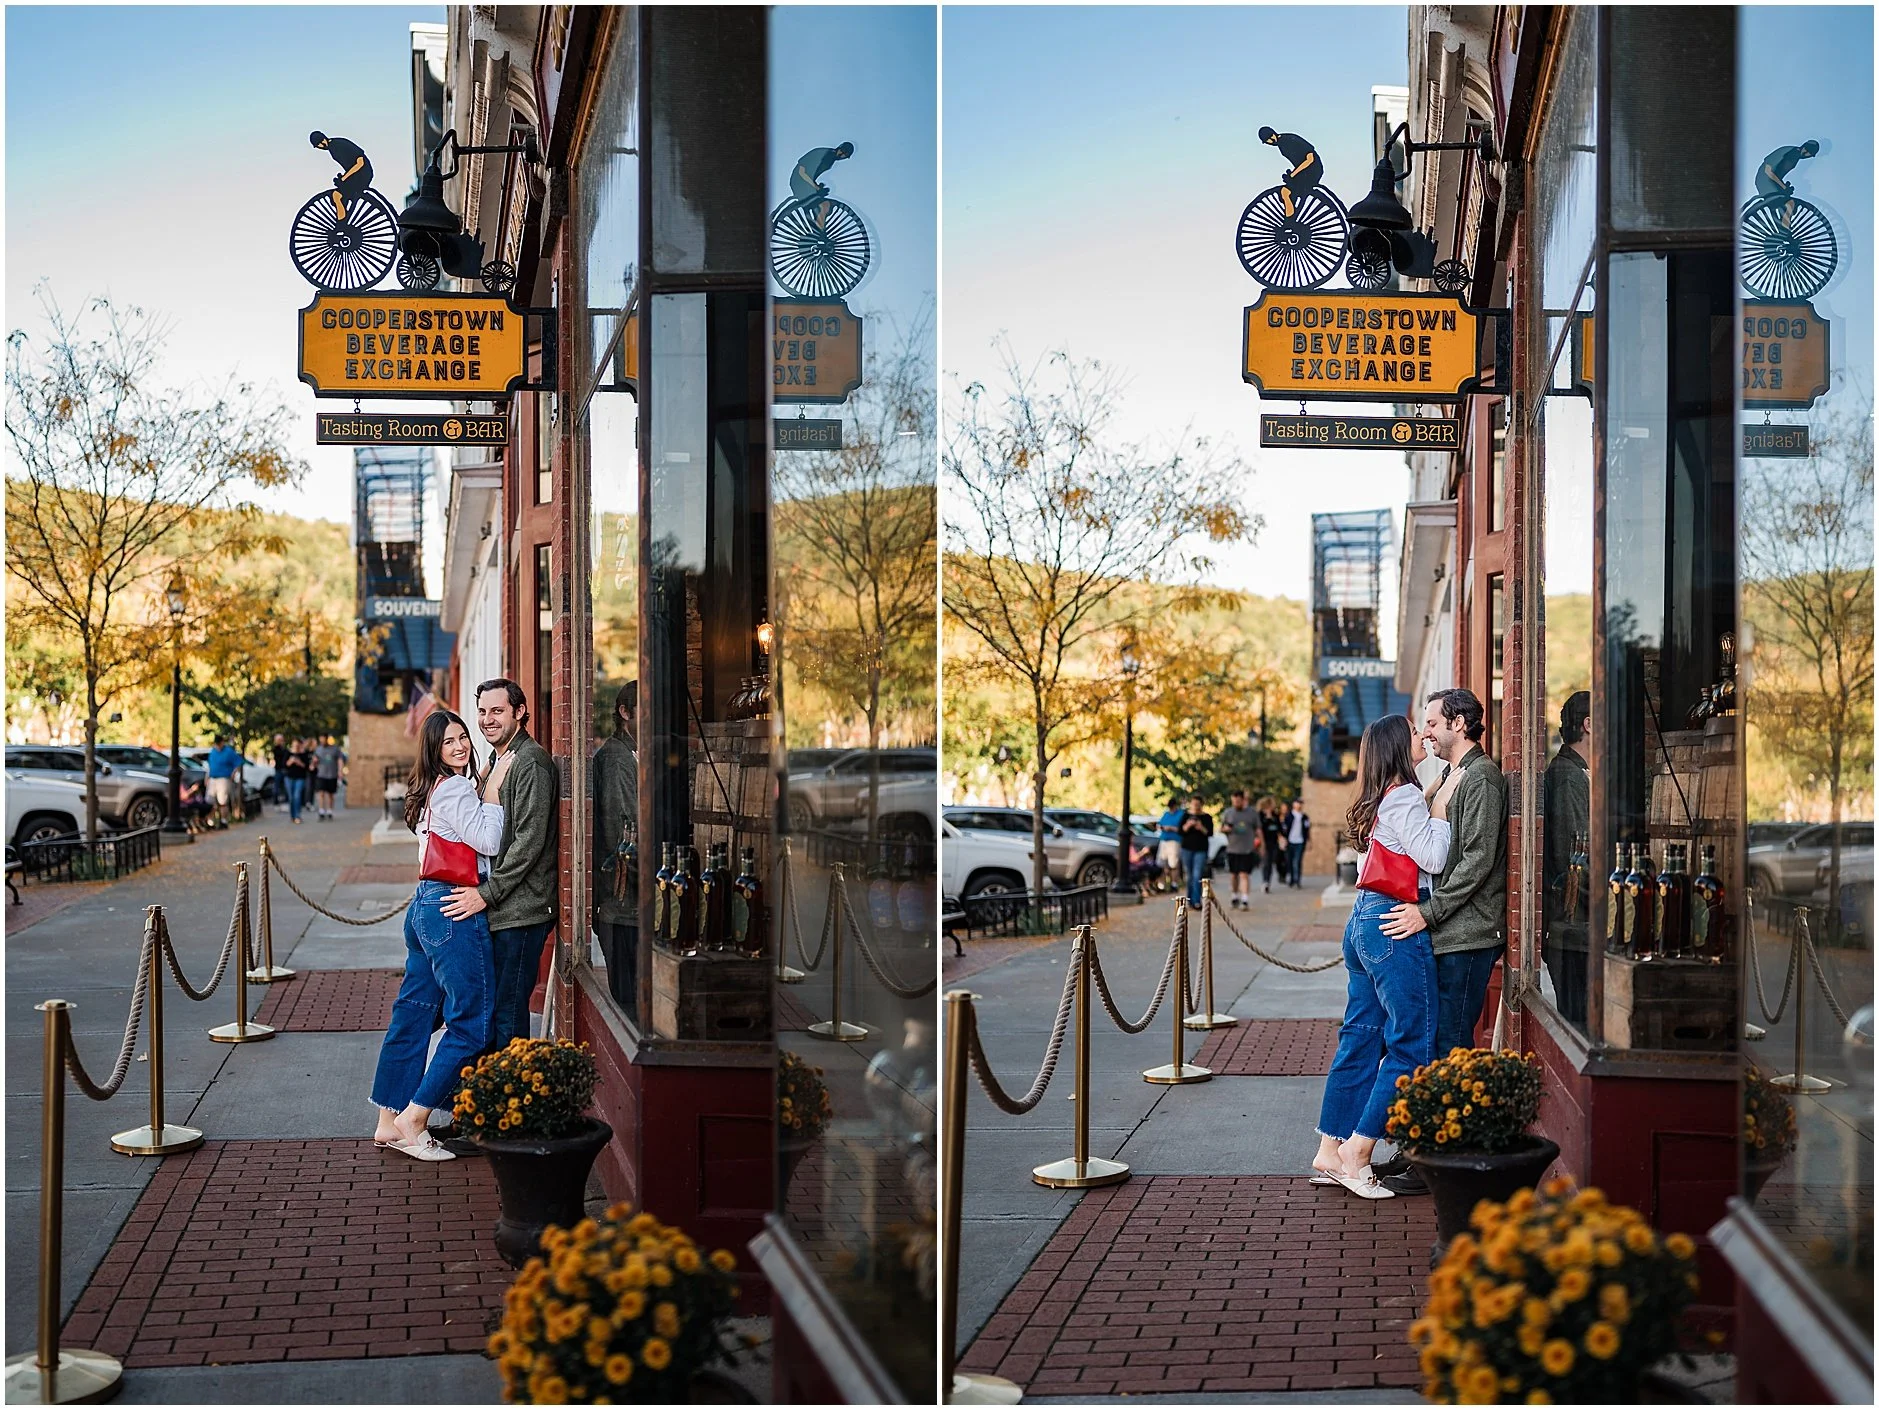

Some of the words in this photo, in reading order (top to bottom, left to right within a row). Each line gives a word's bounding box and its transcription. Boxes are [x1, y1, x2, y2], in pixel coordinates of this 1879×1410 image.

[322, 308, 504, 331] COOPERSTOWN
[1267, 306, 1456, 331] COOPERSTOWN
[346, 333, 481, 356] BEVERAGE
[1292, 332, 1432, 356] BEVERAGE
[345, 358, 481, 381] EXCHANGE
[1291, 358, 1432, 382] EXCHANGE
[321, 418, 383, 439] Tasting
[388, 419, 438, 438] Room
[444, 419, 461, 438] &
[465, 420, 505, 438] BAR
[1265, 420, 1329, 442] Tasting
[1334, 421, 1387, 441] Room
[1393, 422, 1411, 442] &
[1415, 423, 1456, 443] BAR
